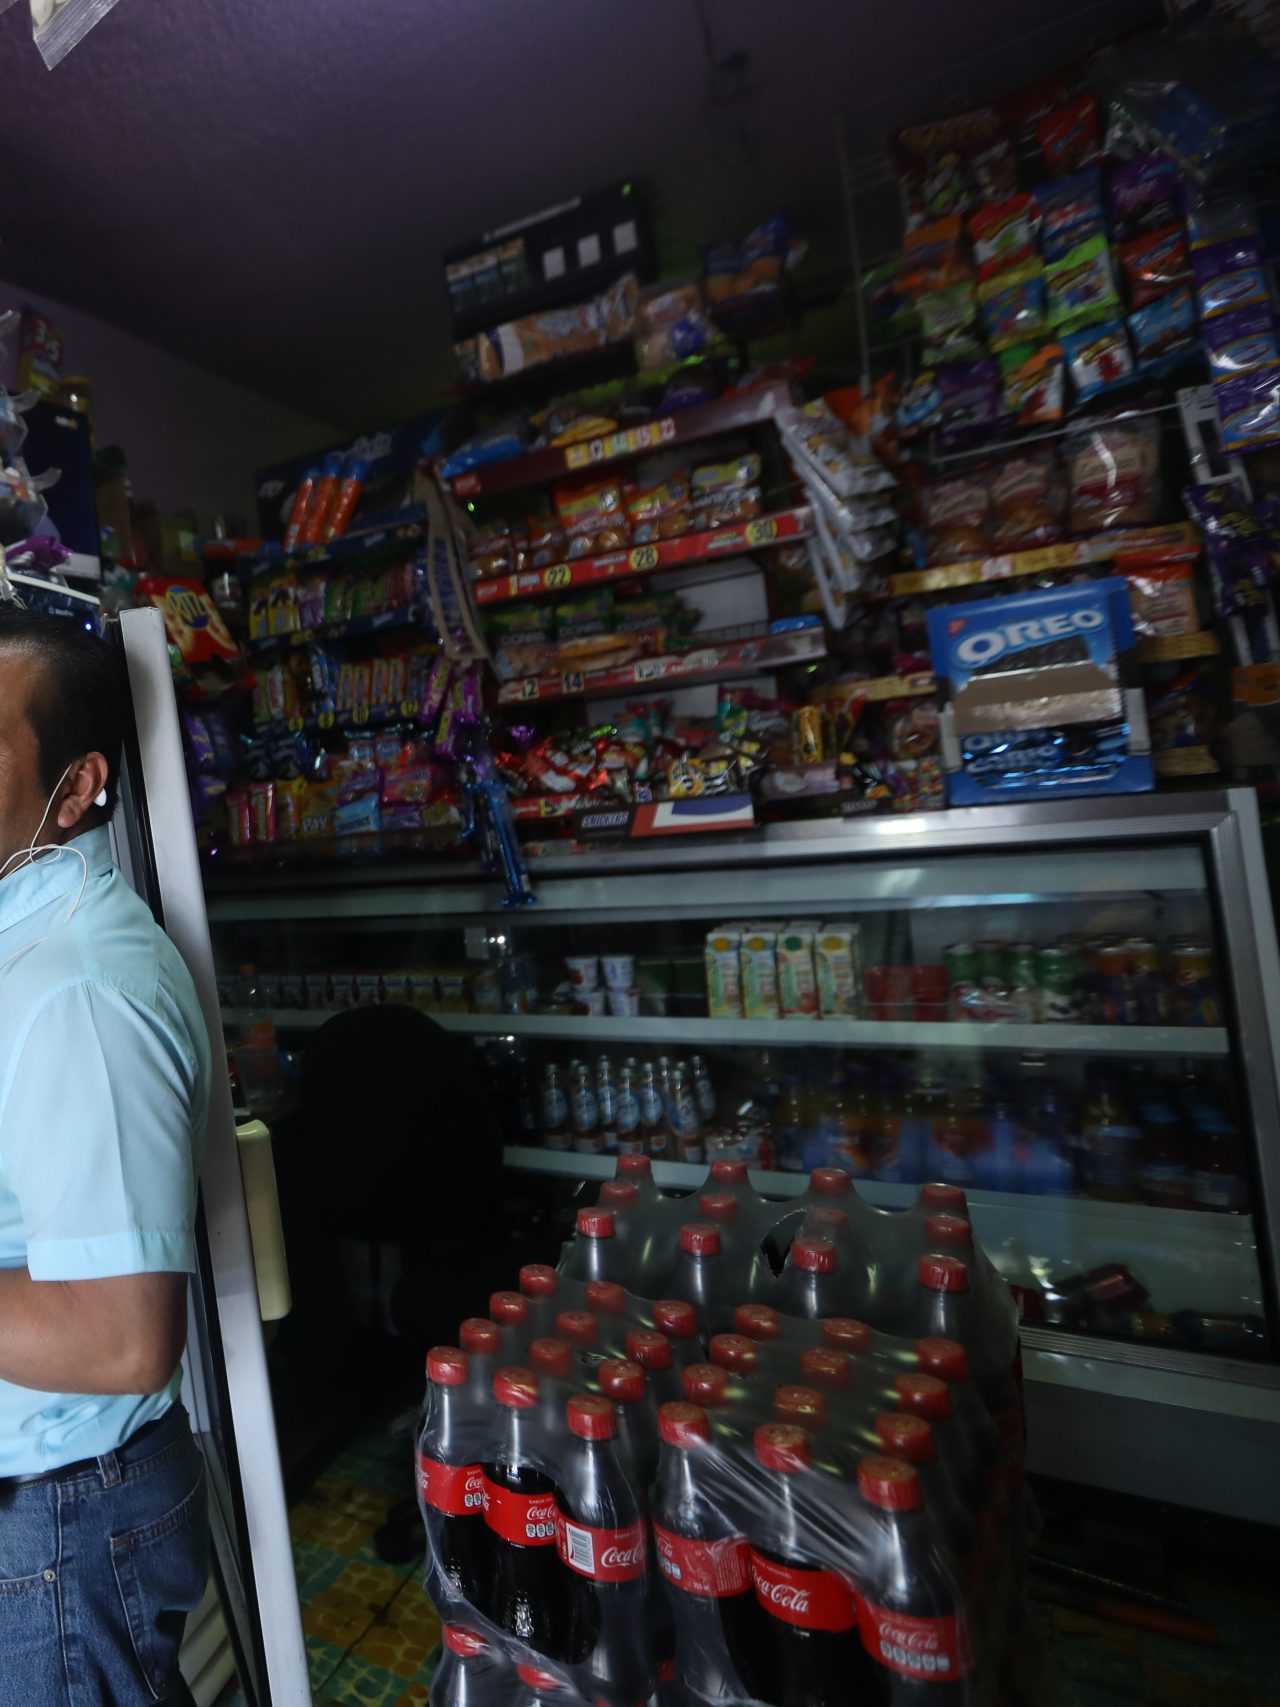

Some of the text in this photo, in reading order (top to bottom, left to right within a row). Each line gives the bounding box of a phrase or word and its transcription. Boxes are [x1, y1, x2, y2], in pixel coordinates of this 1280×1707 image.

[636, 547, 656, 565] 28
[548, 569, 567, 586] 22
[955, 609, 1106, 665] OREO
[563, 673, 582, 691] 14
